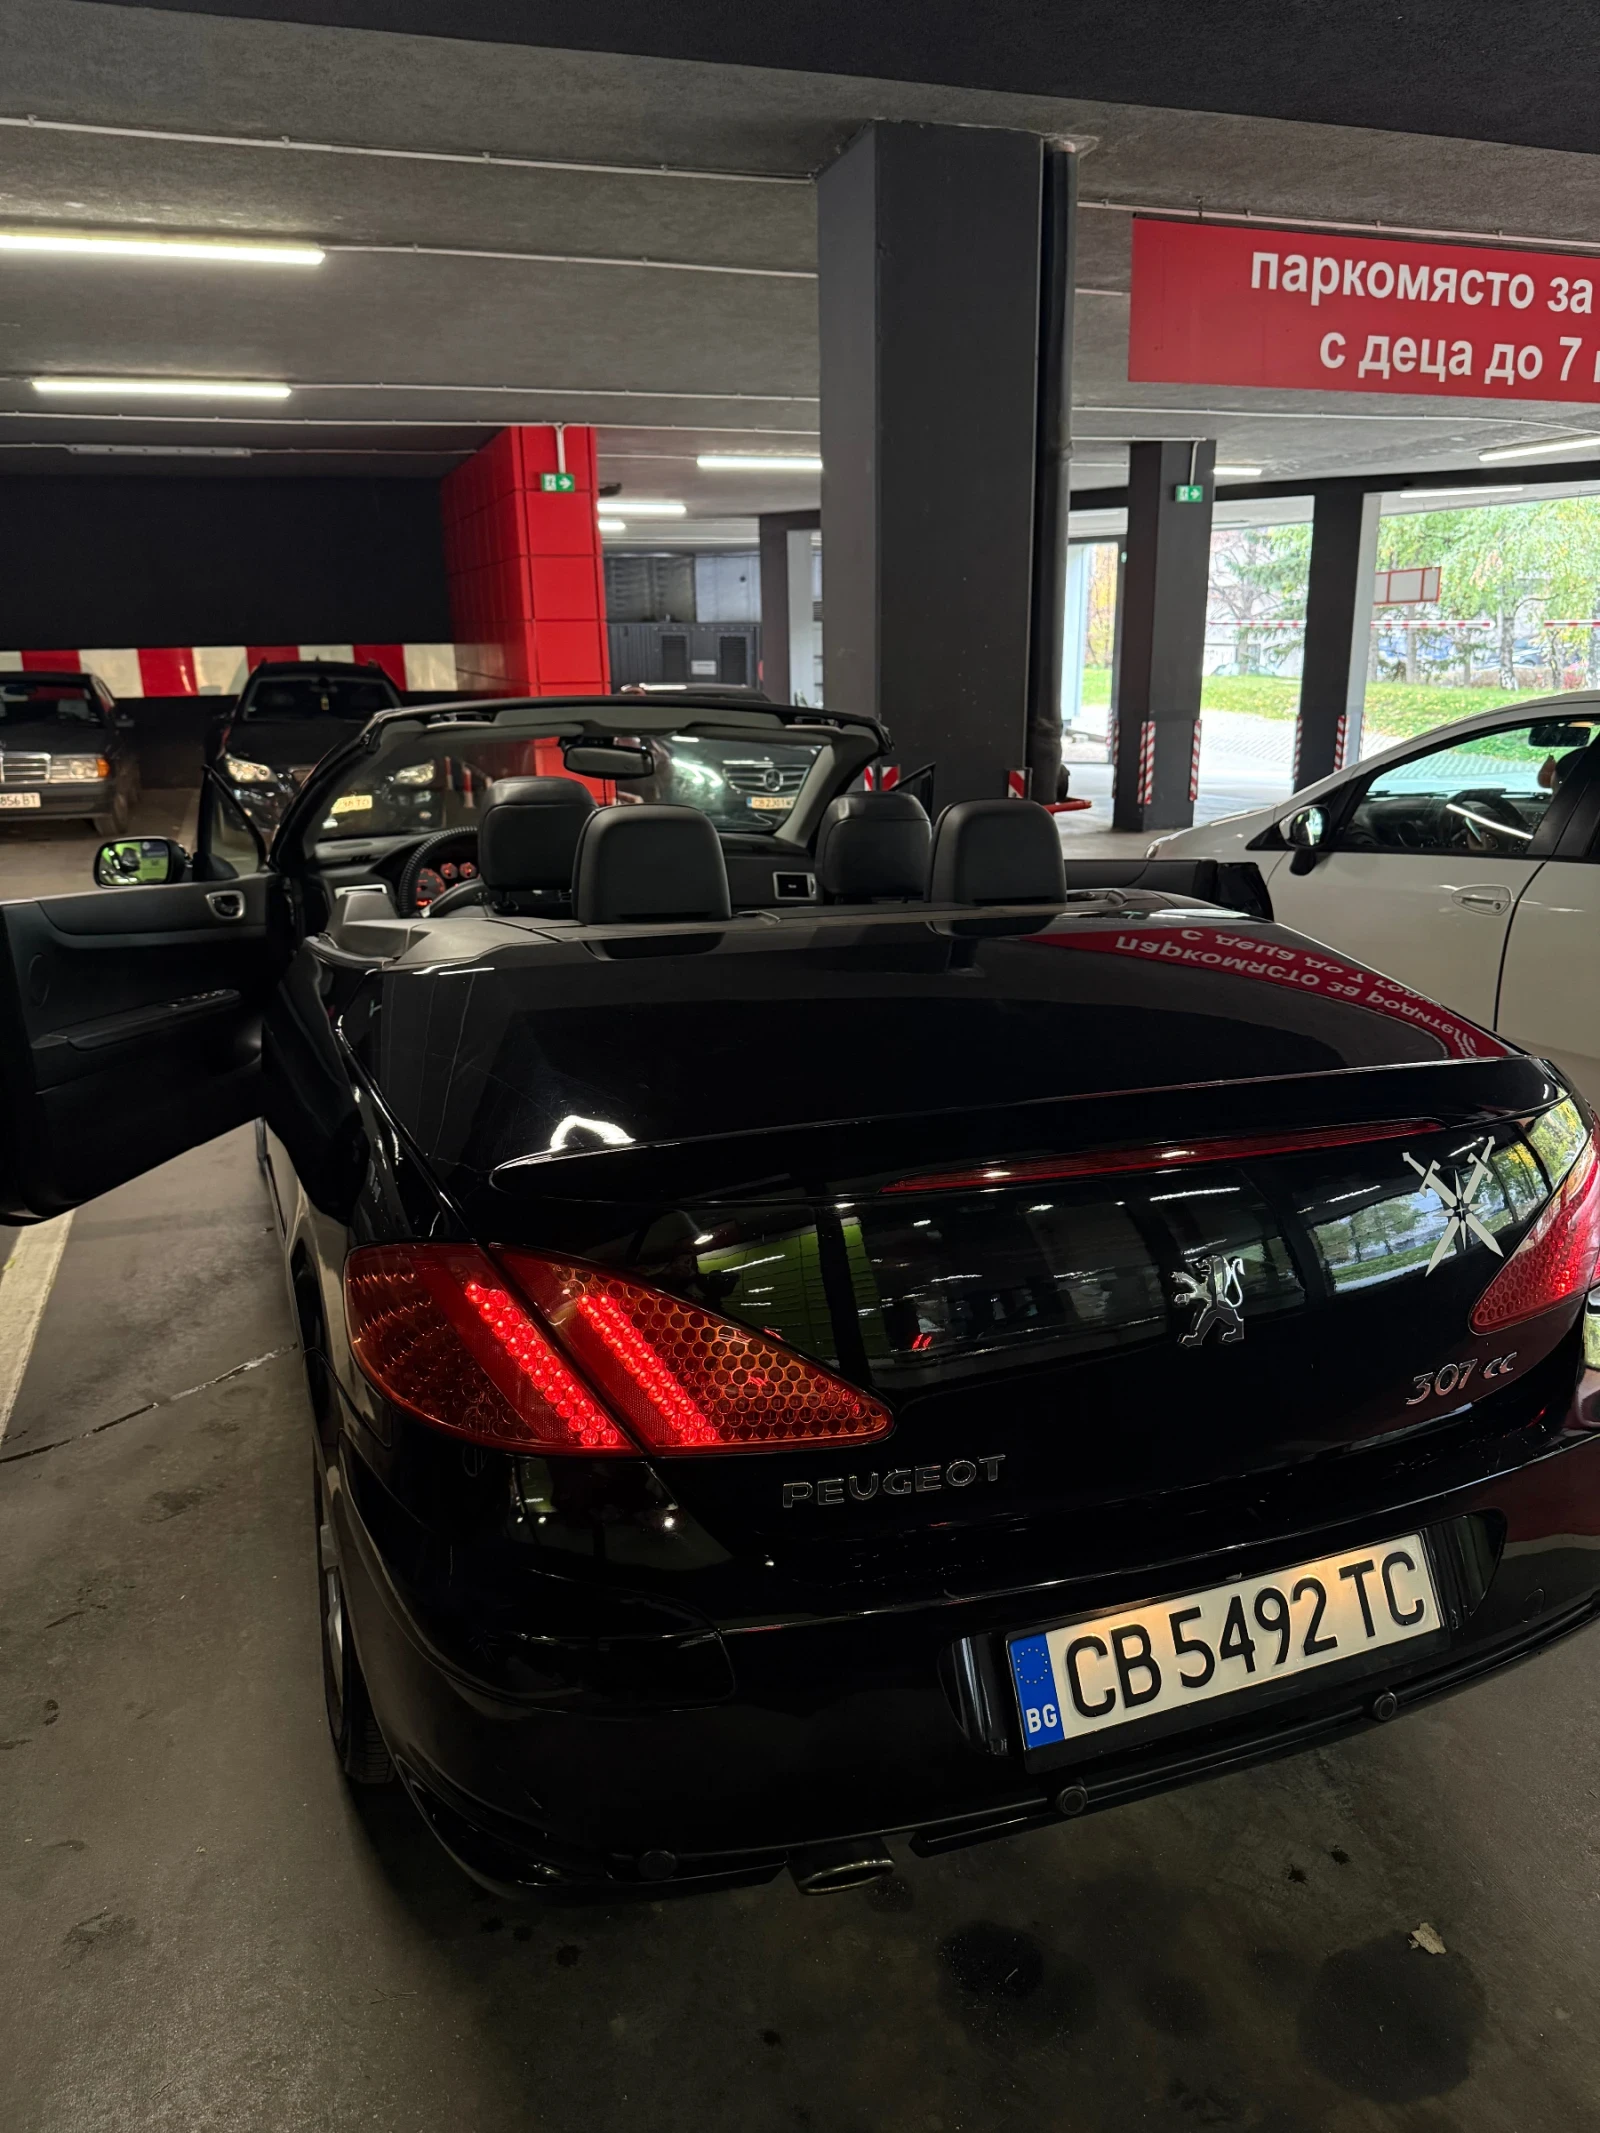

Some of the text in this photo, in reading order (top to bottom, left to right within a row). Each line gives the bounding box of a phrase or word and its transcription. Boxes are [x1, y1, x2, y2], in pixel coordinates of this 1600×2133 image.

[1251, 251, 1592, 314] паркомясто за
[1320, 331, 1346, 369] с
[1358, 334, 1473, 382] деца
[1484, 342, 1544, 385] до
[1559, 336, 1582, 381] 7
[1404, 1358, 1478, 1405] 307
[782, 1453, 1007, 1509] PEUGEOT
[1065, 1550, 1426, 1719] CB 5492 TC
[1025, 1703, 1058, 1734] BG
